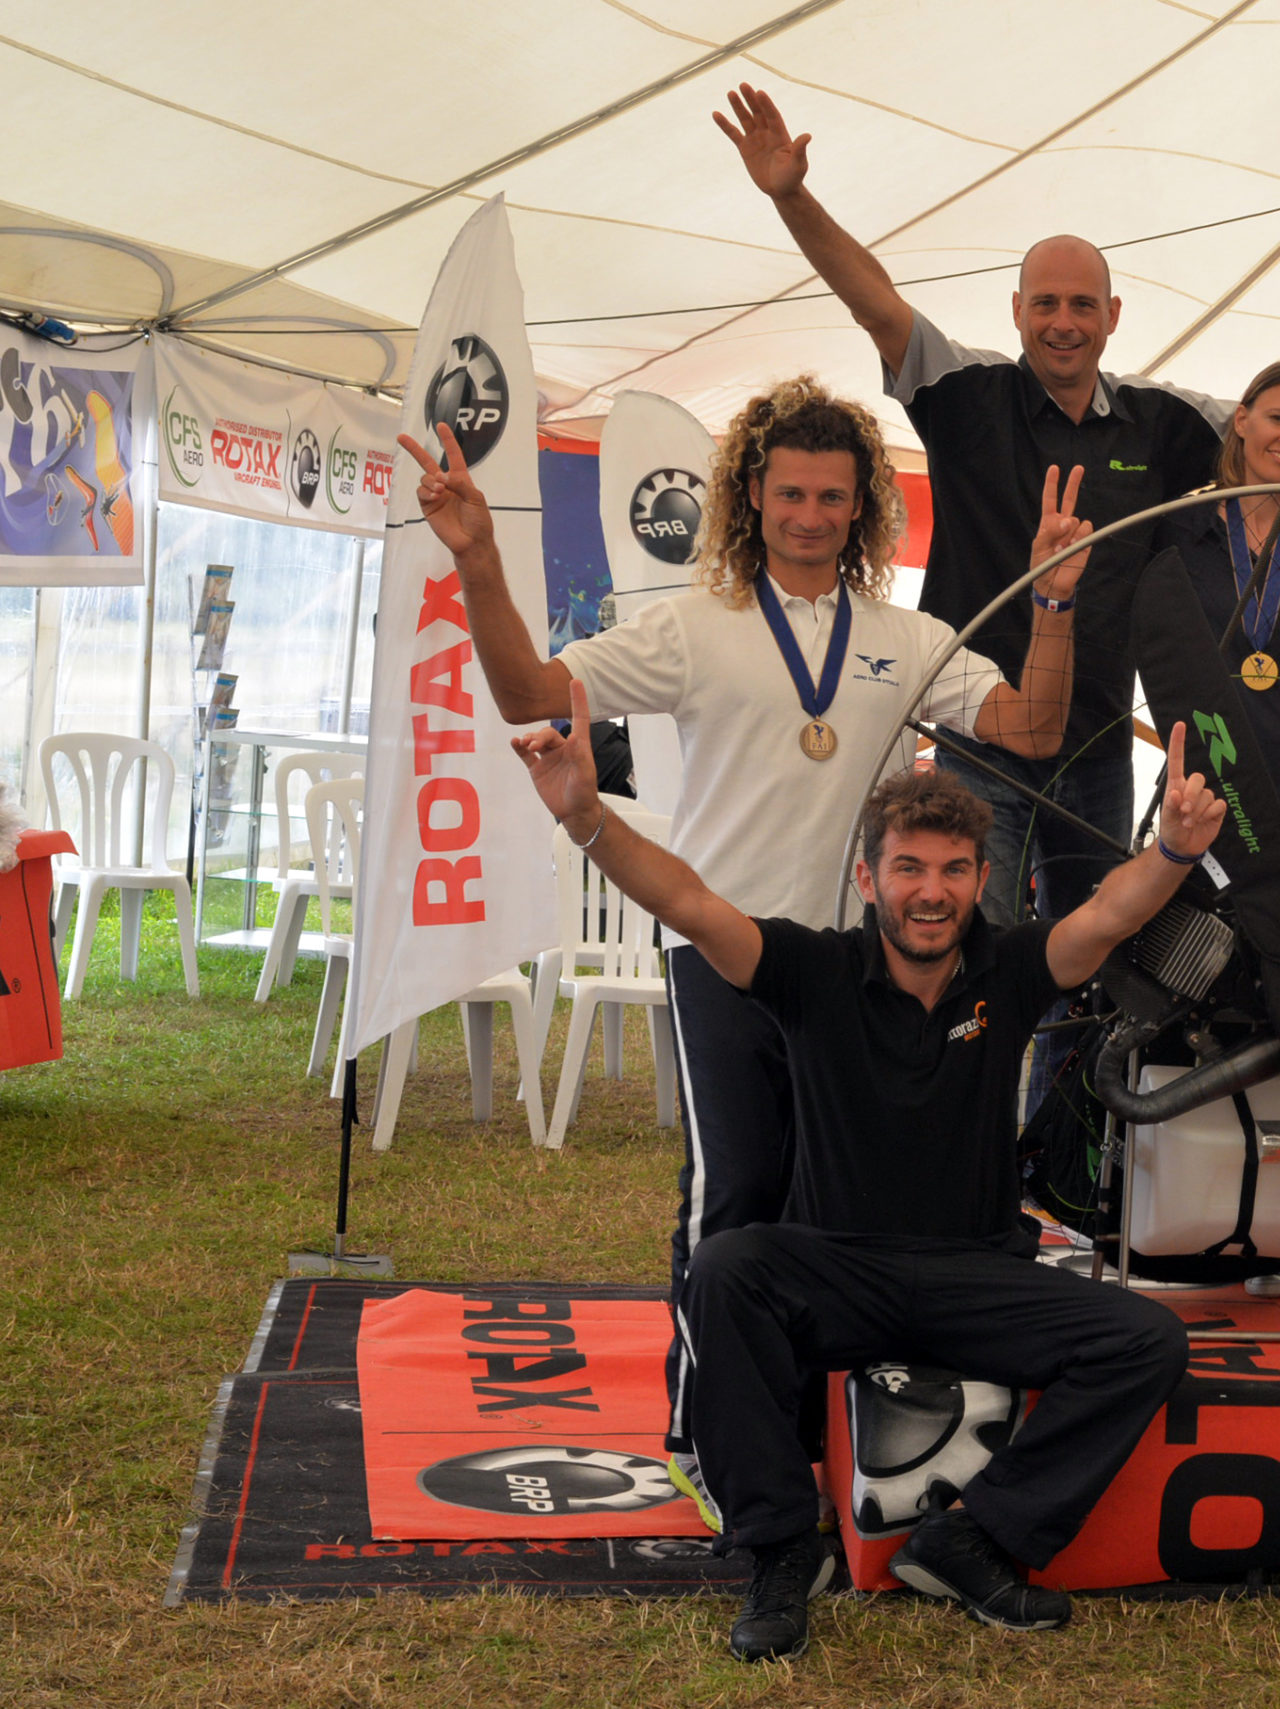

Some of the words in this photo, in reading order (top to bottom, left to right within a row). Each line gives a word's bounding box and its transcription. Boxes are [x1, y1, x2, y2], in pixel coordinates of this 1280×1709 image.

[169, 411, 203, 450] CFS
[455, 407, 501, 431] RP
[183, 450, 204, 467] AERO
[210, 429, 282, 478] ROTAX
[333, 448, 358, 481] CFS
[302, 471, 319, 484] BRP
[339, 481, 354, 496] AERO
[410, 569, 486, 927] ROTAX
[1222, 782, 1261, 855] ultralight
[459, 1294, 601, 1413] ROTAX
[506, 1473, 554, 1513] BRP
[304, 1540, 571, 1561] ROTAX
